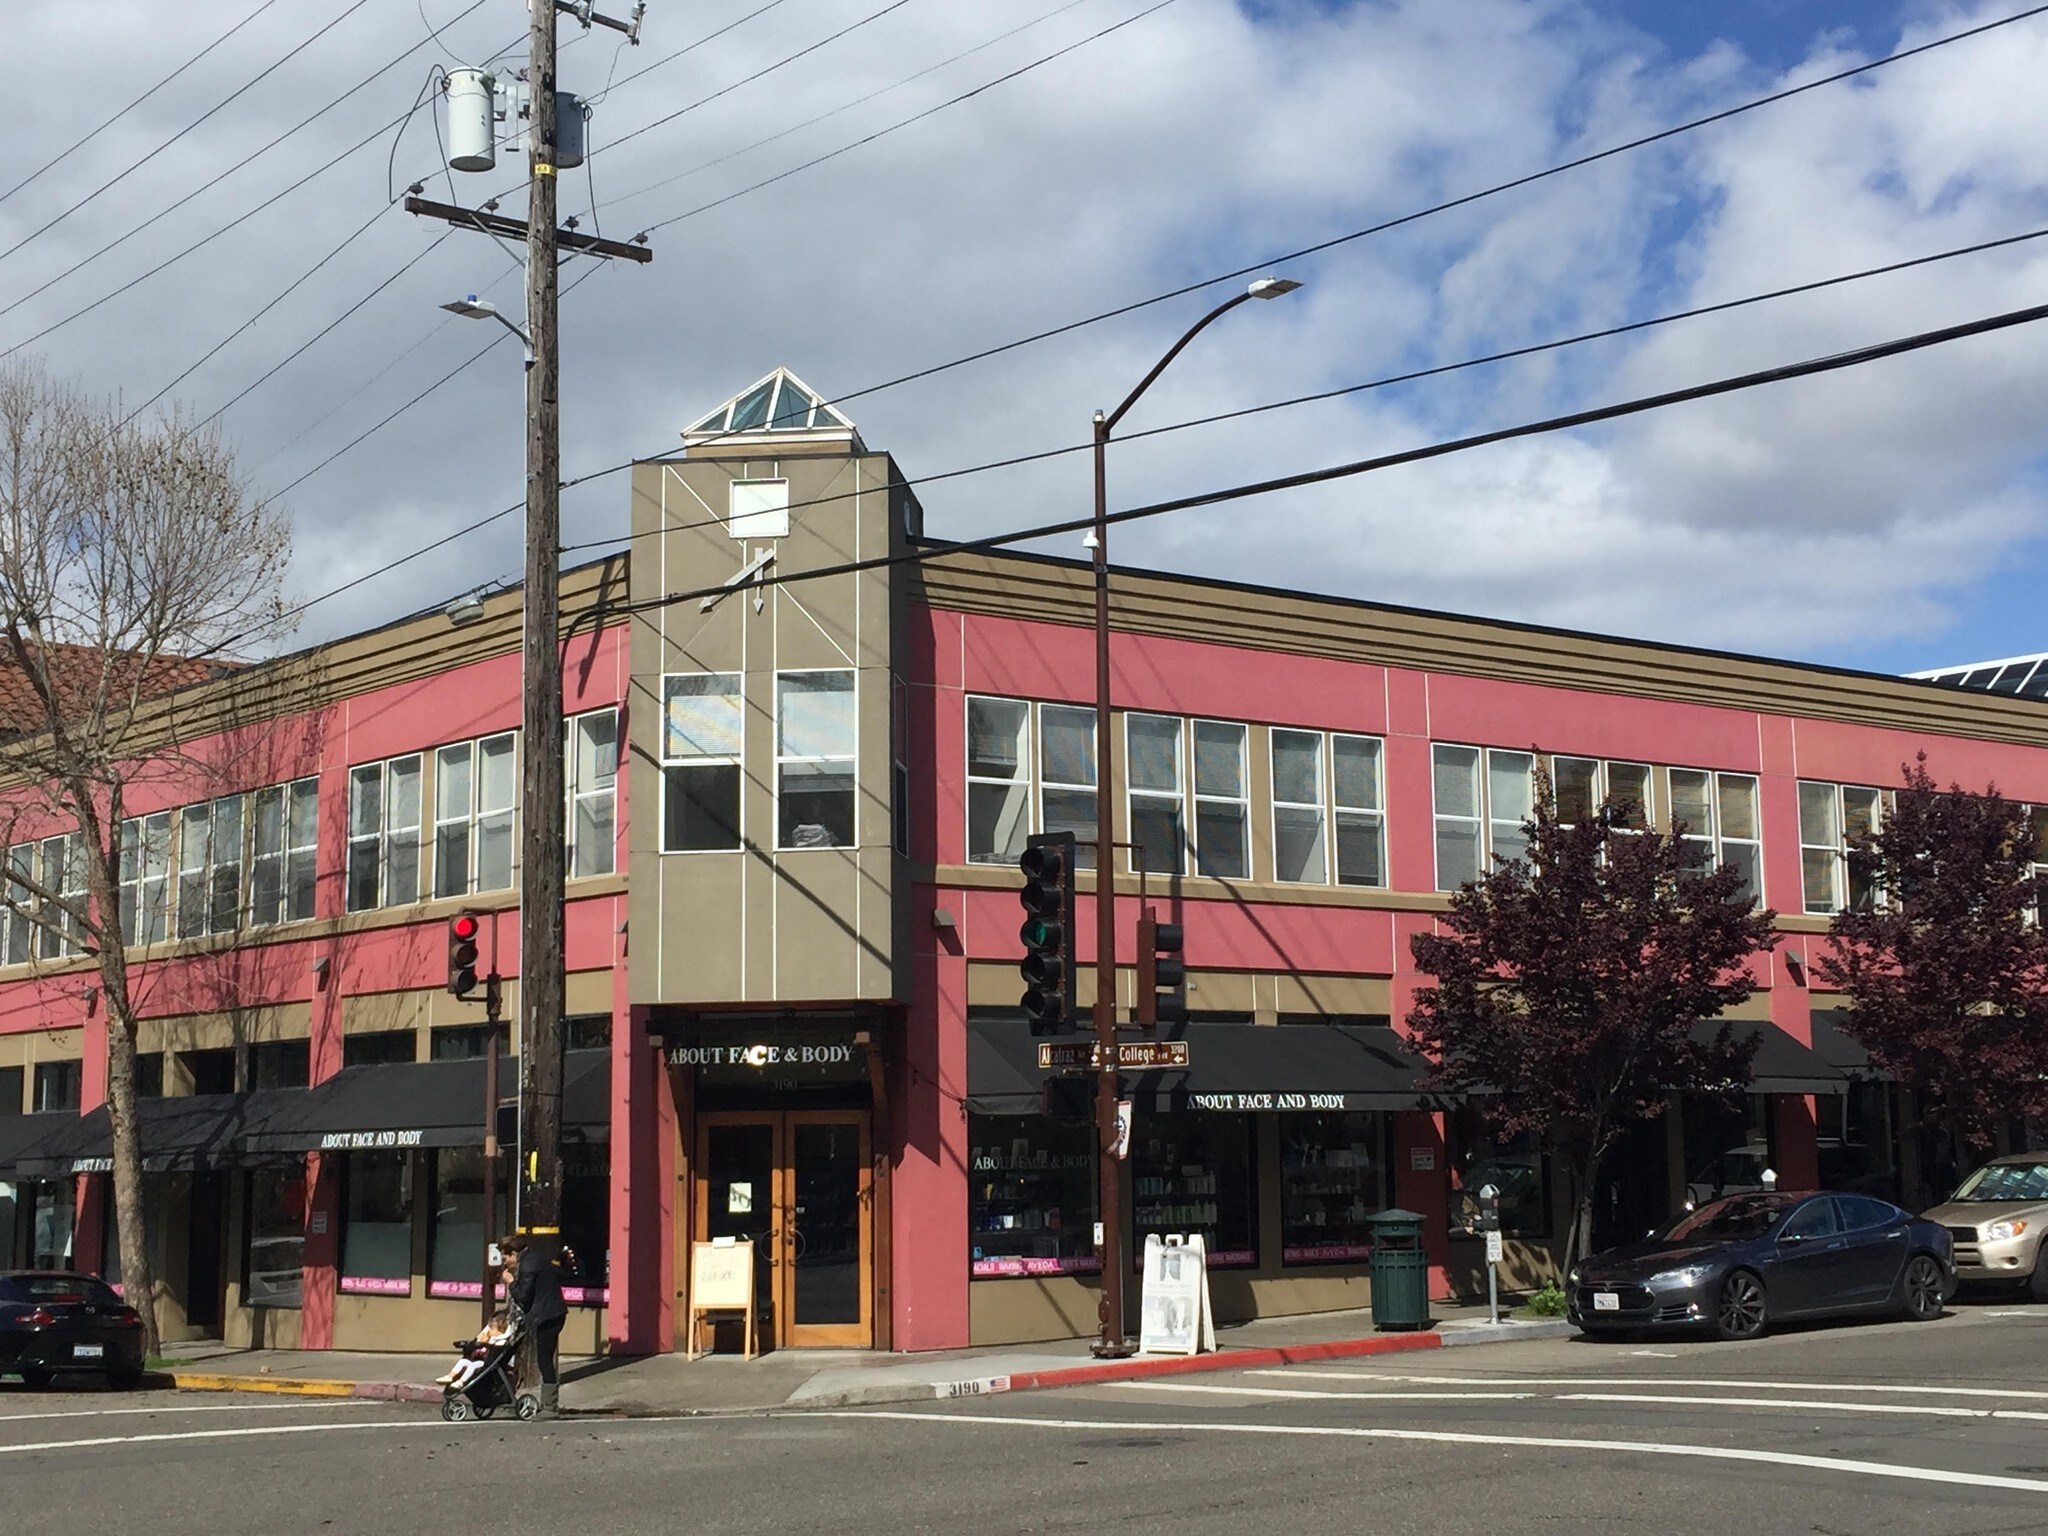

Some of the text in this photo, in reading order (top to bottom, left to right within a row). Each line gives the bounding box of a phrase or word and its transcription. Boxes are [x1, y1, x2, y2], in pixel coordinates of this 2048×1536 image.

[669, 1045, 854, 1066] ABOUT FACE & BODY
[1041, 1047, 1075, 1065] Alcatraz
[1119, 1046, 1155, 1065] College
[1186, 1094, 1345, 1109] ABOUT FACE AND BODY
[321, 1130, 423, 1148] ABOUT FACE AND BODY
[974, 1156, 1016, 1170] ABOUT
[949, 1381, 980, 1396] 3190
